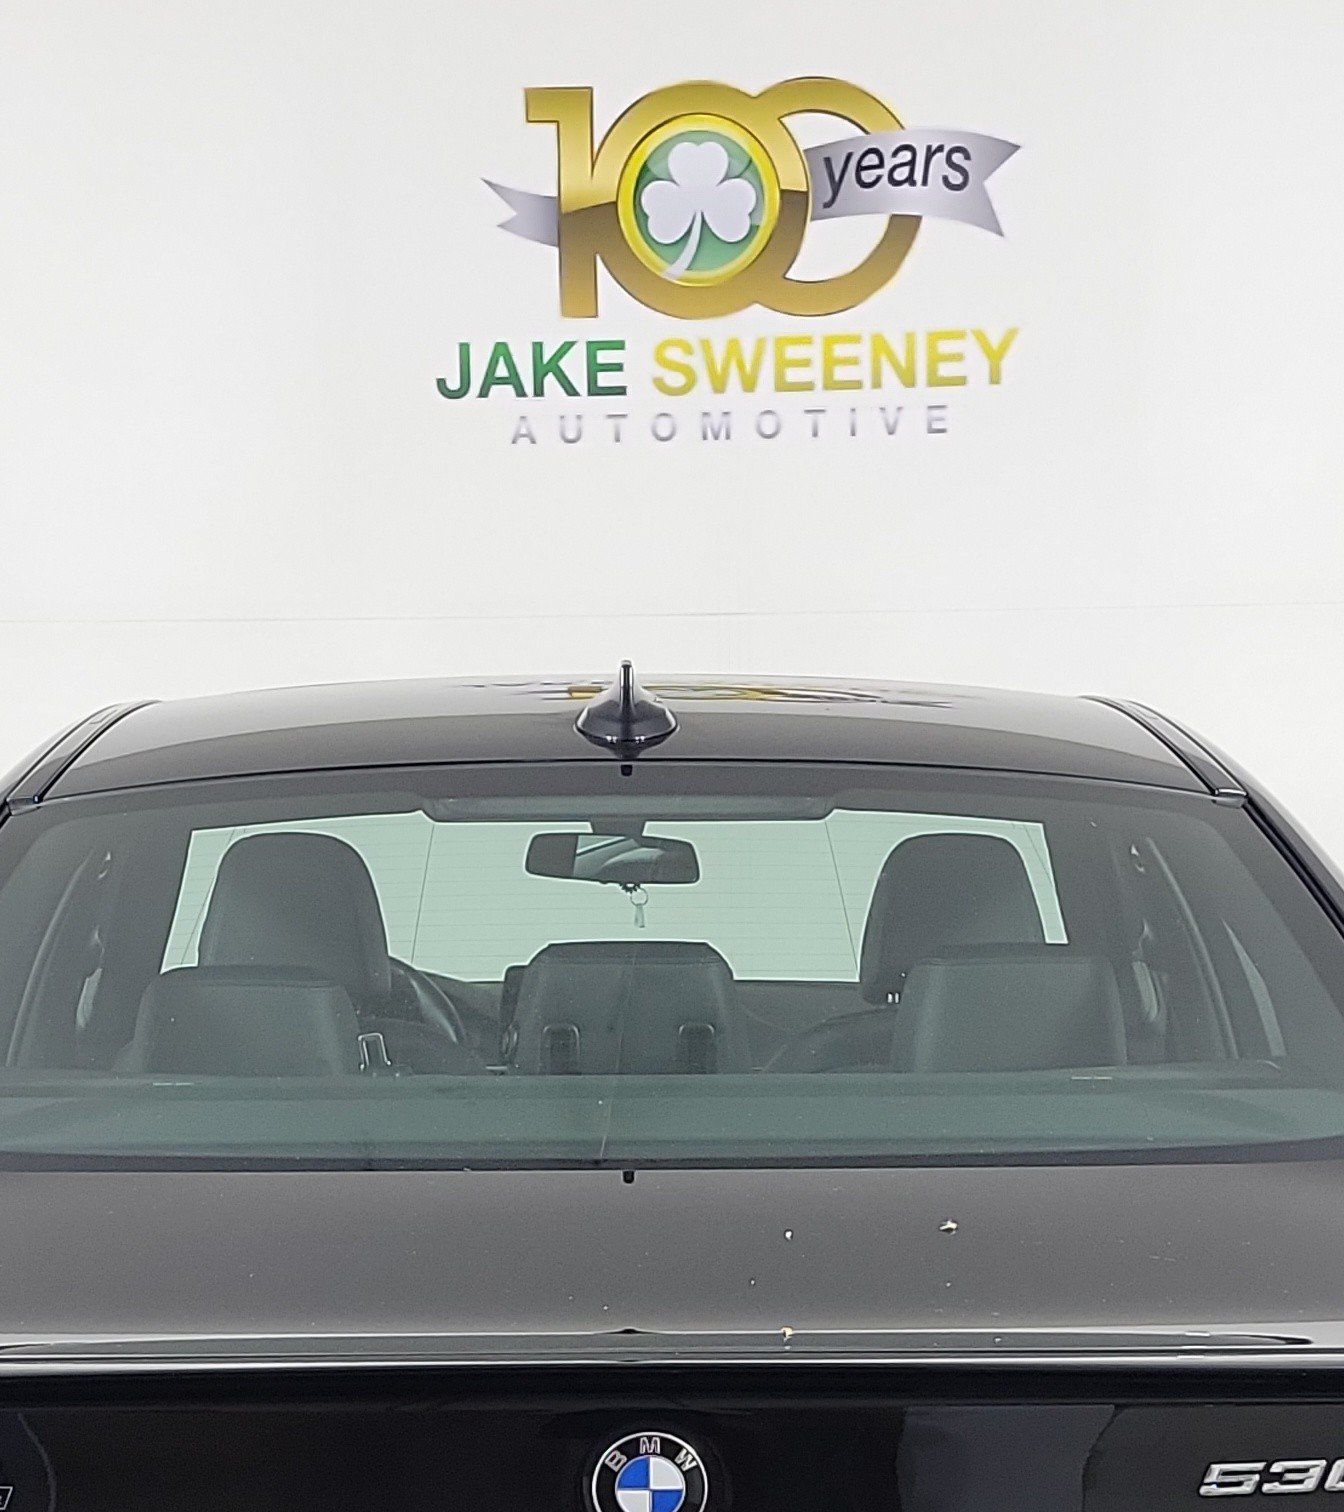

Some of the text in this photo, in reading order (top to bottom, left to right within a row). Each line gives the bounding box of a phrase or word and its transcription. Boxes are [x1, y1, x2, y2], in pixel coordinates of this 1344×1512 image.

[524, 76, 923, 319] 100
[822, 142, 972, 210] years
[435, 327, 1020, 399] JAKE SWEENEY
[511, 405, 949, 445] AUTOMOTIVE
[605, 1437, 698, 1472] BMW
